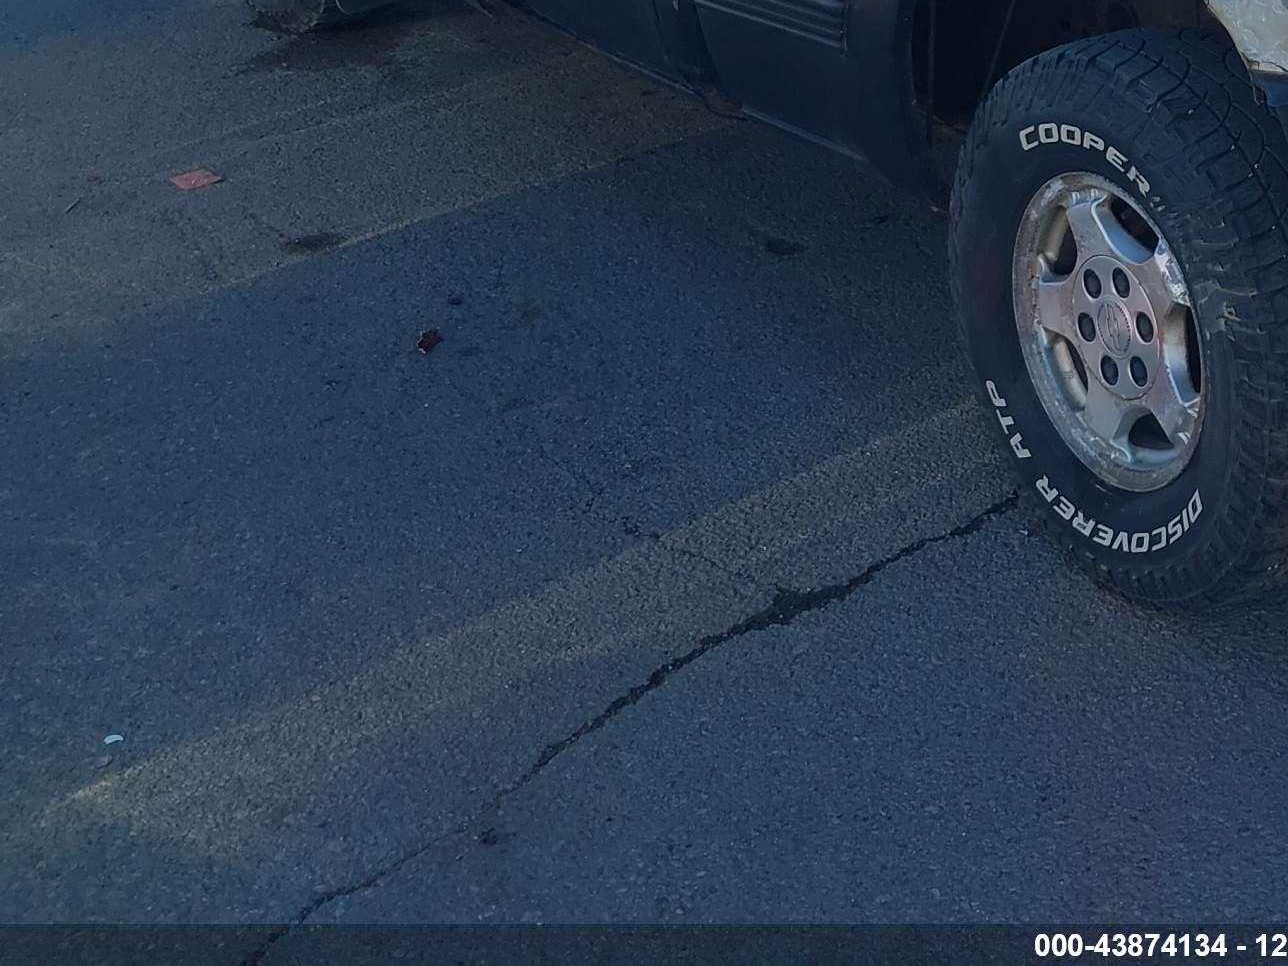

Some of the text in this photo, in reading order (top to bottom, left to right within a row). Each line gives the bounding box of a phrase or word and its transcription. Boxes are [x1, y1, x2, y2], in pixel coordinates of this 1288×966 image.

[1019, 122, 1151, 197] COOPER
[985, 380, 1204, 553] DISCOVERER ATP
